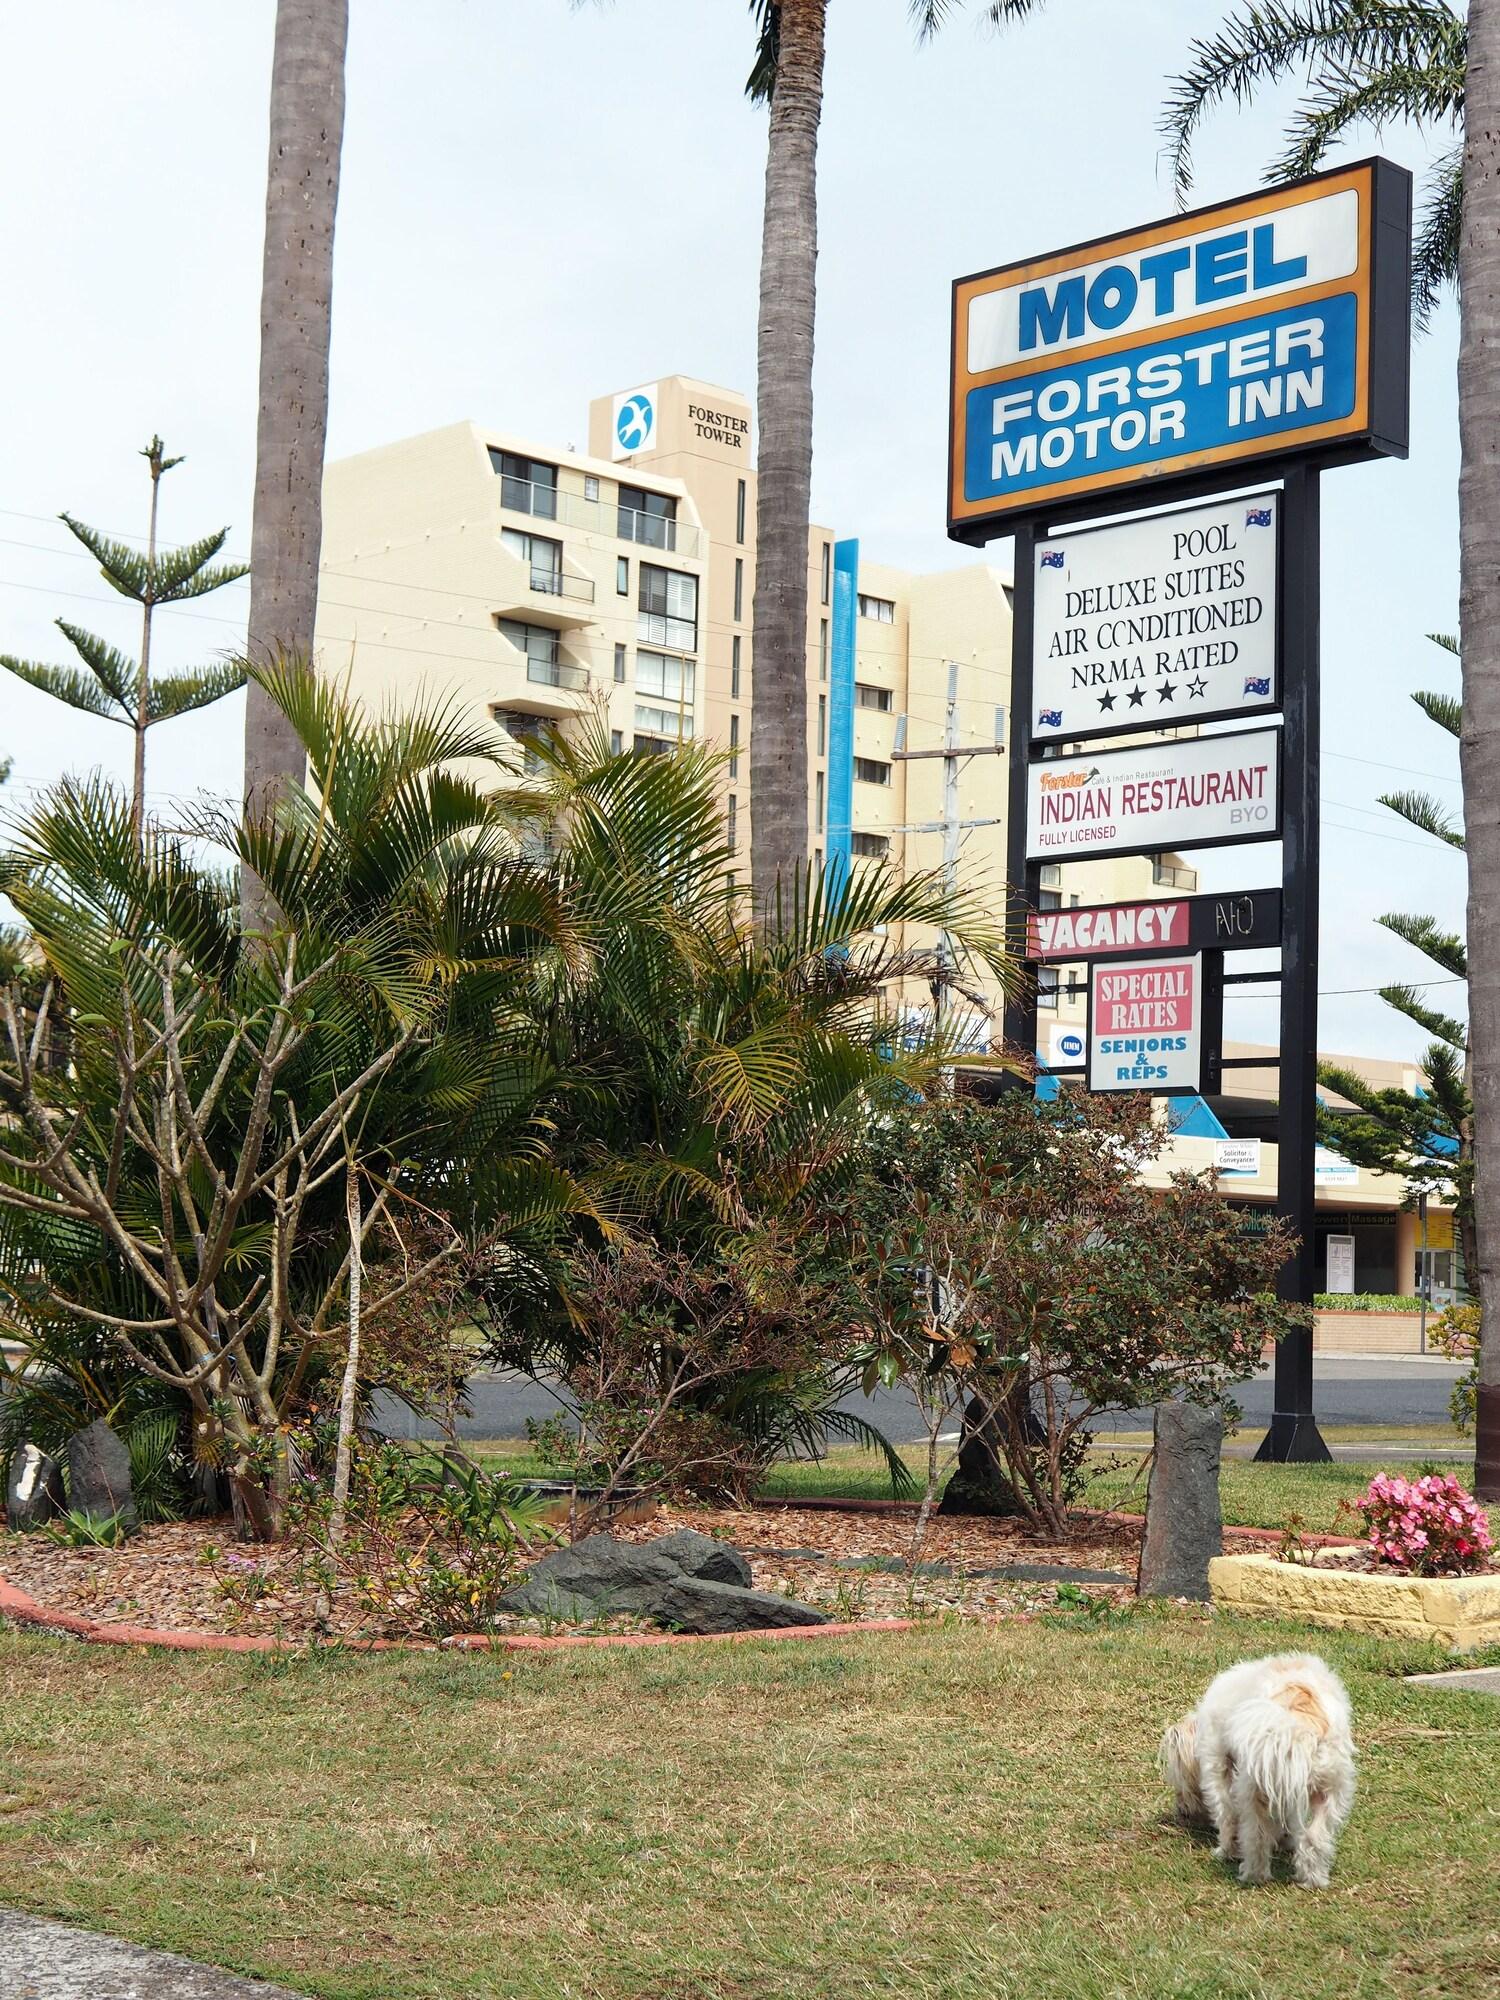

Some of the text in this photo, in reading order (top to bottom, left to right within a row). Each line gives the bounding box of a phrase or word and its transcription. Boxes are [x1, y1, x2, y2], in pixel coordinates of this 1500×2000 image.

[1019, 223, 1307, 352] MOTEL
[992, 318, 1324, 435] FORSTER
[688, 404, 749, 434] FORSTER
[991, 365, 1324, 481] MOTOR INN
[695, 423, 742, 448] TOWER
[1173, 524, 1237, 560] POOL
[1065, 560, 1245, 618] DELUXE SUITES
[1049, 627, 1088, 658] AIR
[1071, 640, 1239, 688] NRMA RATED
[1040, 771, 1087, 792] Forster
[1106, 775, 1111, 784] &
[1113, 773, 1134, 783] Indian
[1135, 768, 1174, 779] Restaurant
[1040, 766, 1268, 825] INDIAN RESTAURANT
[1230, 805, 1269, 825] BYO
[1039, 825, 1117, 846] FULLY LICENSED
[1036, 906, 1177, 950] VACANCY
[1215, 896, 1254, 937] NO
[1101, 971, 1189, 1002] SPECIAL
[1111, 1000, 1178, 1030] RATES
[1100, 1036, 1187, 1054] SENIORS
[1135, 1053, 1149, 1065] &
[1116, 1065, 1168, 1080] REPS
[1219, 1156, 1255, 1164] Conveyancer
[1351, 1215, 1396, 1225] Massage
